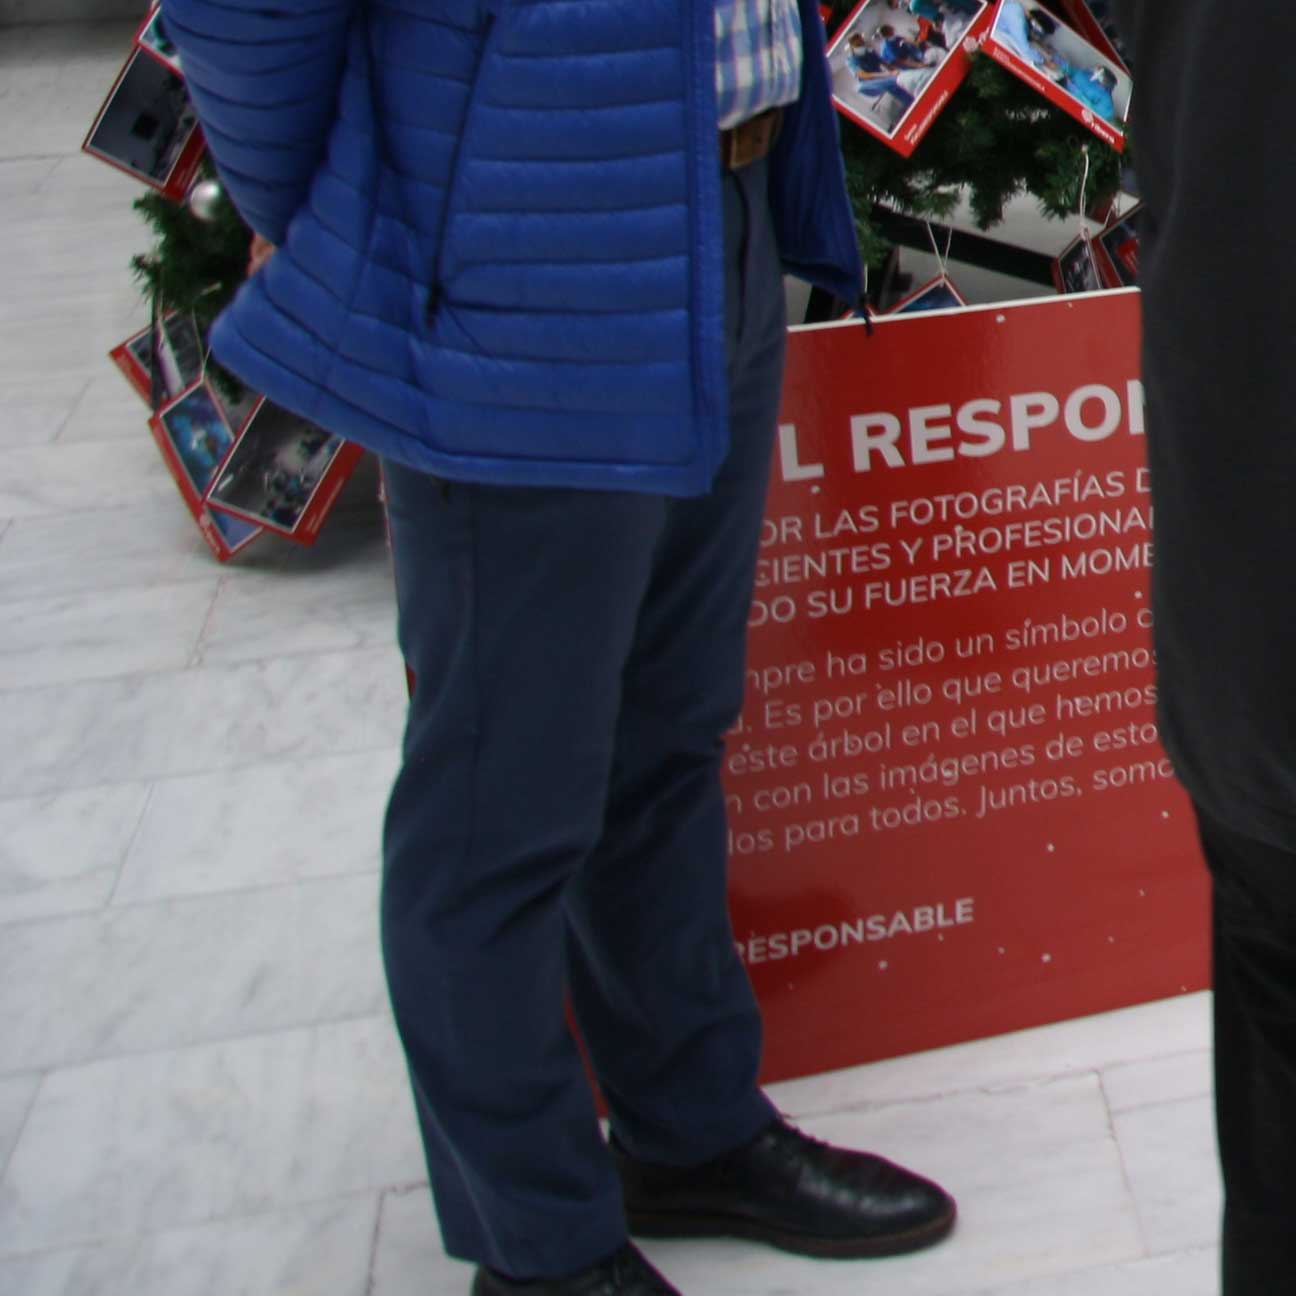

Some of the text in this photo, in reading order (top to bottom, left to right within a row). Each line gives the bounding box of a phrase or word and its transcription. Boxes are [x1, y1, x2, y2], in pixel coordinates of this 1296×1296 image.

[754, 505, 1154, 587] CIENTES Y PROFESIONA
[760, 515, 803, 546] OR
[814, 505, 880, 539] LAS
[890, 469, 1126, 528] FOTOGRAFÍAS
[748, 543, 1155, 627] DO SU FUERZA EN MOME
[826, 650, 867, 679] ha
[879, 636, 945, 671] sido
[955, 632, 994, 658] un
[1005, 607, 1127, 651] símbolo
[728, 684, 1159, 775] este árbol en el que hemos
[764, 700, 802, 729] Es
[813, 692, 868, 729] por
[876, 679, 932, 711] ello
[942, 671, 1002, 705] que
[1012, 647, 1159, 692] queremo
[728, 757, 1175, 857] los para todos. Juntos, somo
[753, 782, 813, 811] con
[823, 772, 870, 799] las
[880, 743, 1035, 791] imágenes
[1045, 731, 1084, 760] de
[1093, 721, 1159, 753] esto
